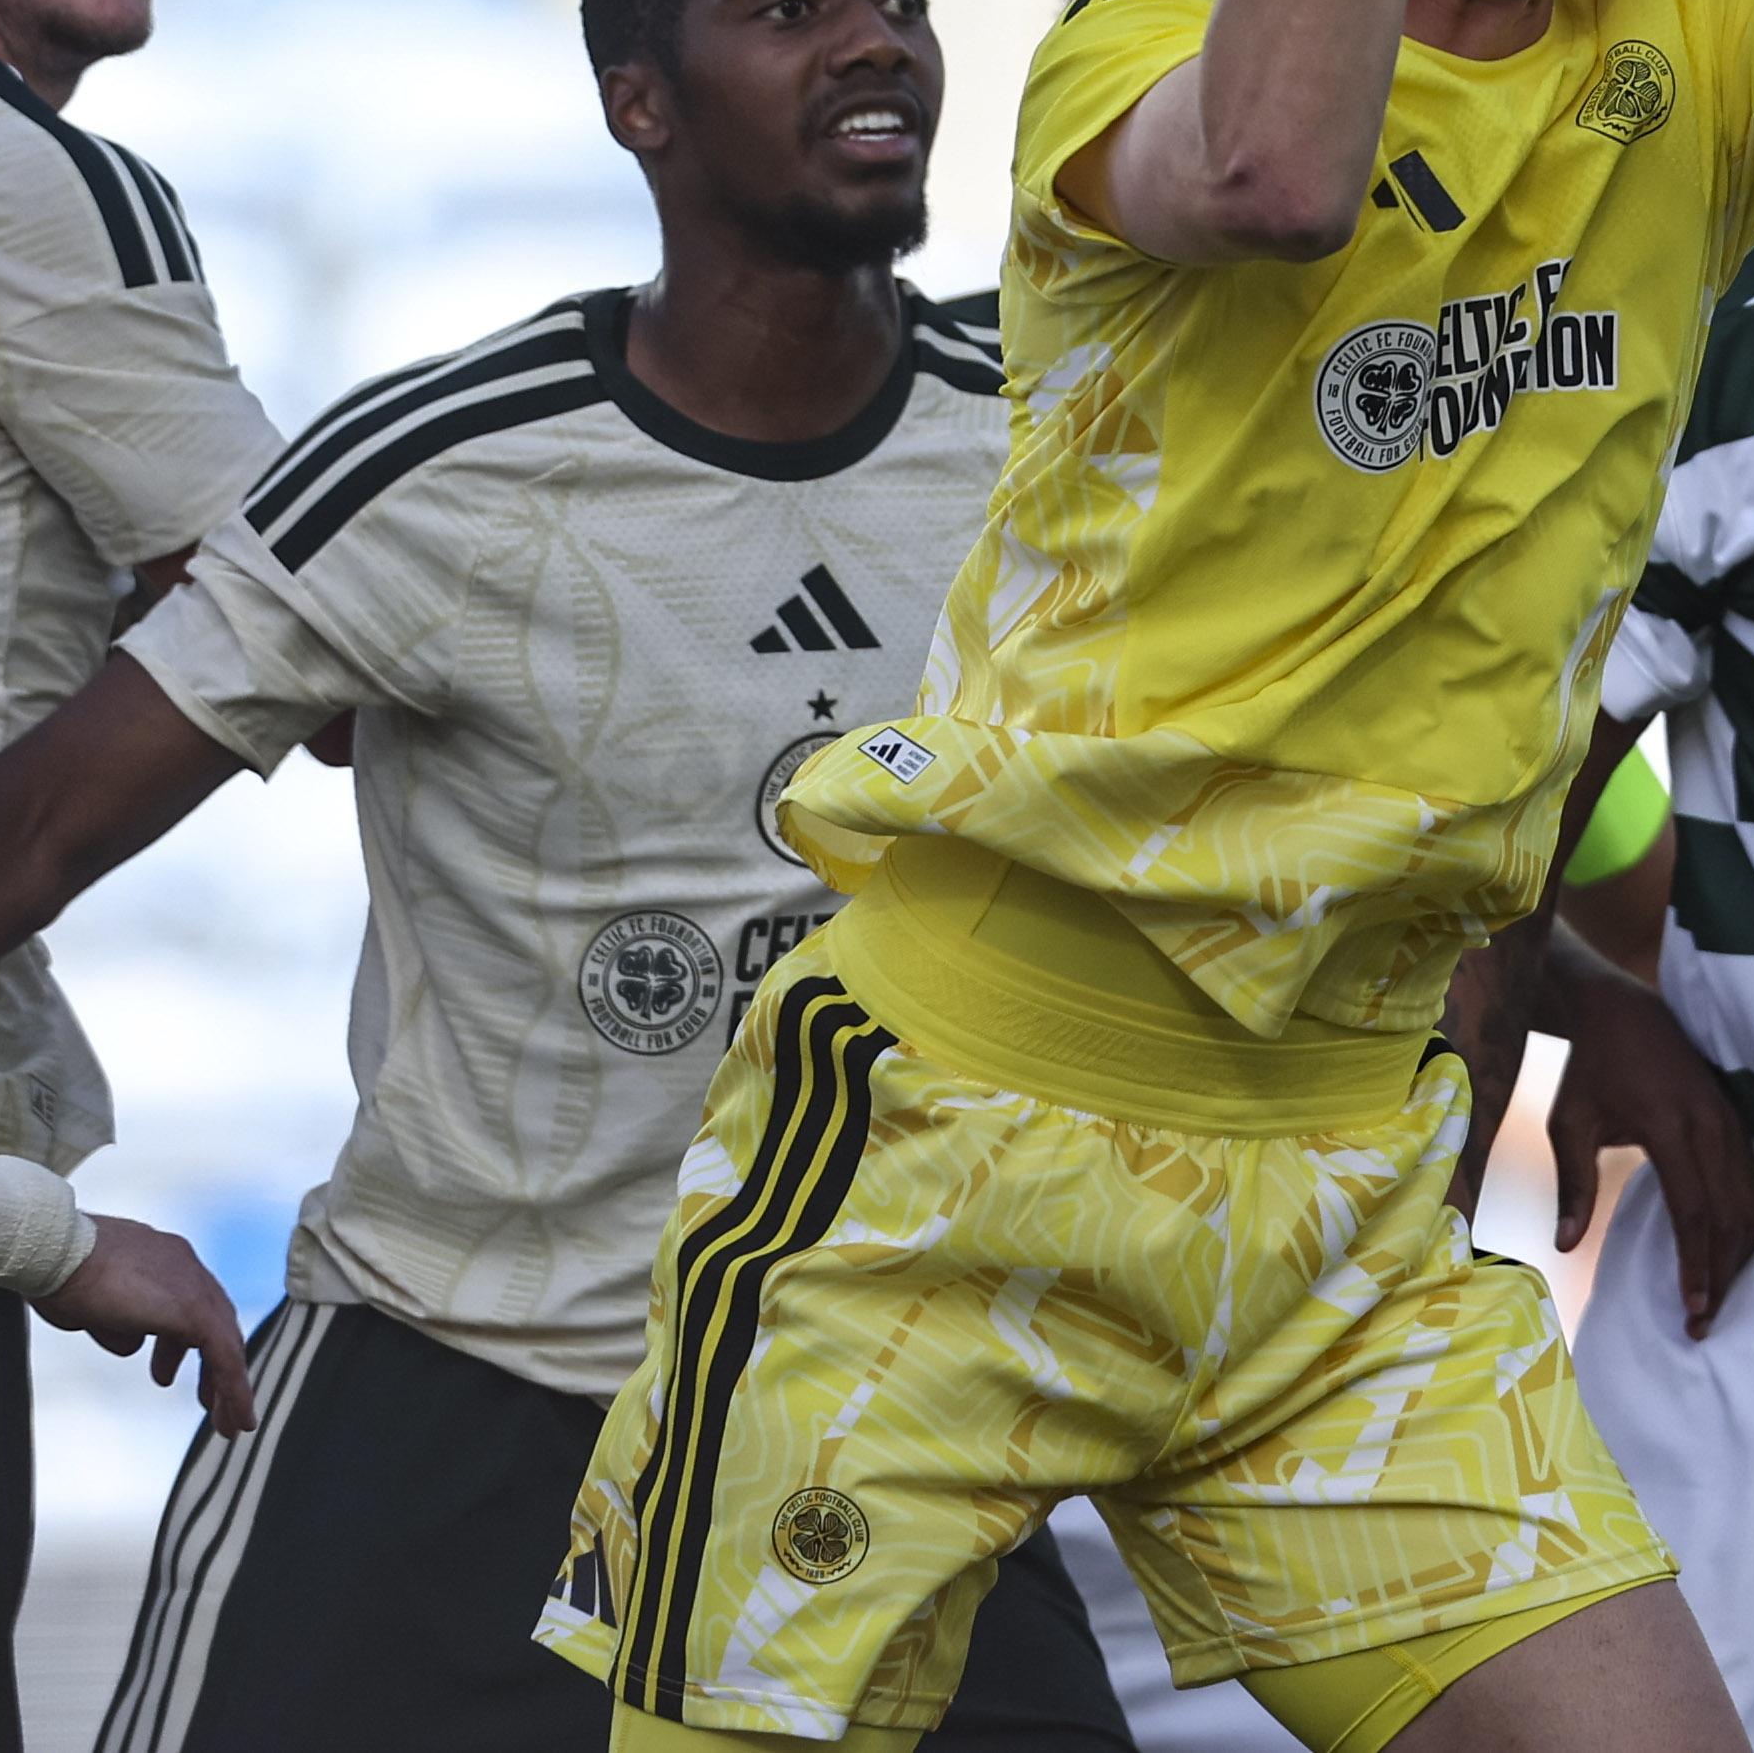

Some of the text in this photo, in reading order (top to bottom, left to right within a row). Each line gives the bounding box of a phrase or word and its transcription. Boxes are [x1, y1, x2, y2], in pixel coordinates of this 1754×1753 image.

[1645, 50, 1669, 76] CLUB
[1333, 337, 1373, 376] CELTIC
[1377, 332, 1392, 348] FC
[1429, 282, 1527, 380] ELTIC
[1328, 383, 1340, 398] 18
[1326, 409, 1375, 463] FOOTBALL
[1379, 445, 1401, 463] FOR
[591, 924, 628, 964] CELTIC
[629, 917, 644, 934] FC
[588, 998, 640, 1047] FOOTBALL
[648, 1031, 673, 1048] FOR
[675, 1007, 708, 1040] GOOD
[778, 1492, 864, 1542] THE CELTIC FOOTBALL CLUB
